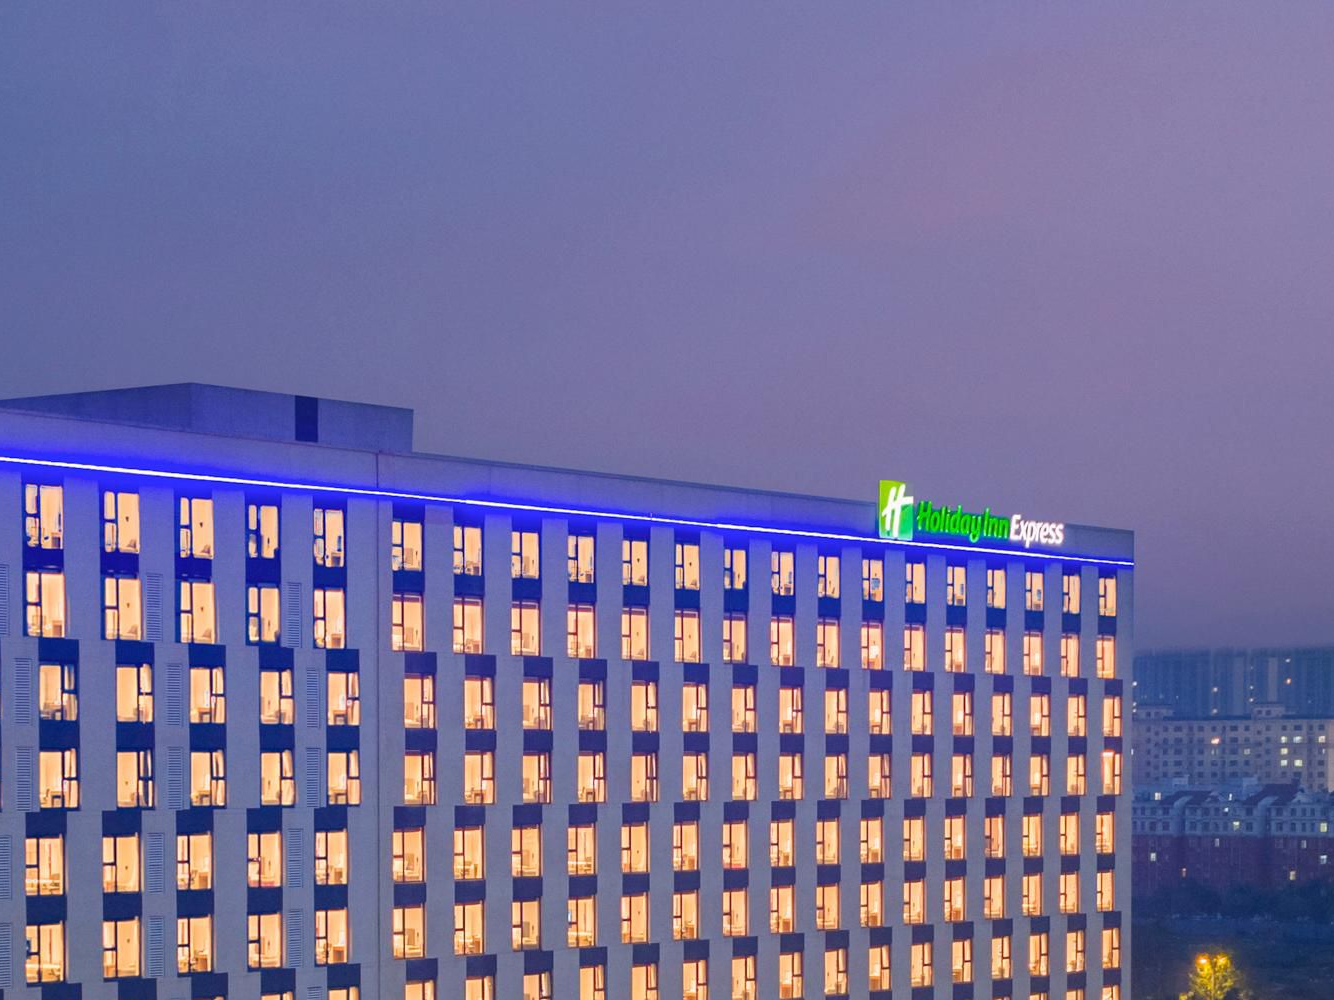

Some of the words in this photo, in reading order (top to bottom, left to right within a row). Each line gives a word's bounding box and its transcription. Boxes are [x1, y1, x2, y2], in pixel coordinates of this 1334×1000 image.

[916, 499, 982, 543] Holiday
[983, 507, 1010, 539] Inn
[1010, 513, 1065, 548] Express
